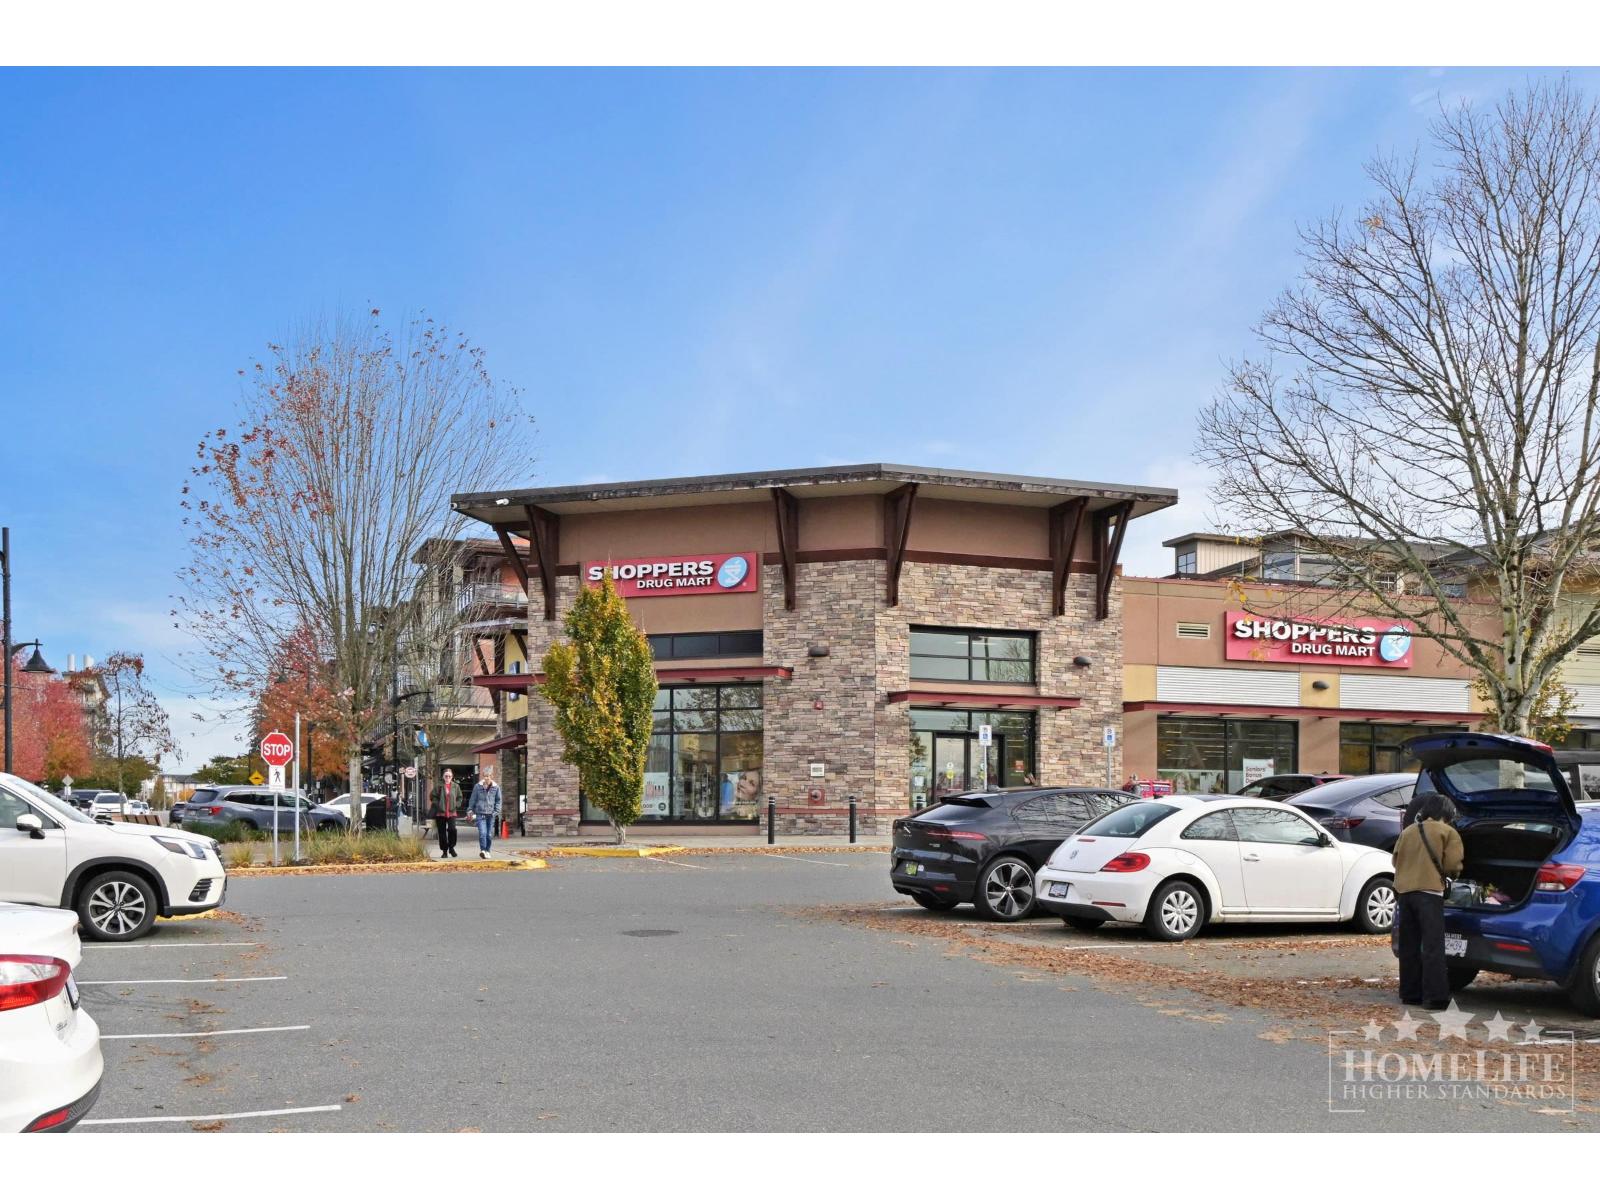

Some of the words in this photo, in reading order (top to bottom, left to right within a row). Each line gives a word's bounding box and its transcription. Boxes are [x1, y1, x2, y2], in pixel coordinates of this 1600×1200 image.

[636, 579, 673, 589] DRUG
[676, 577, 713, 587] MART
[1235, 620, 1376, 644] SHOPPERS
[1292, 643, 1332, 655] DRUG
[1335, 645, 1375, 656] MART
[263, 743, 290, 757] STOP
